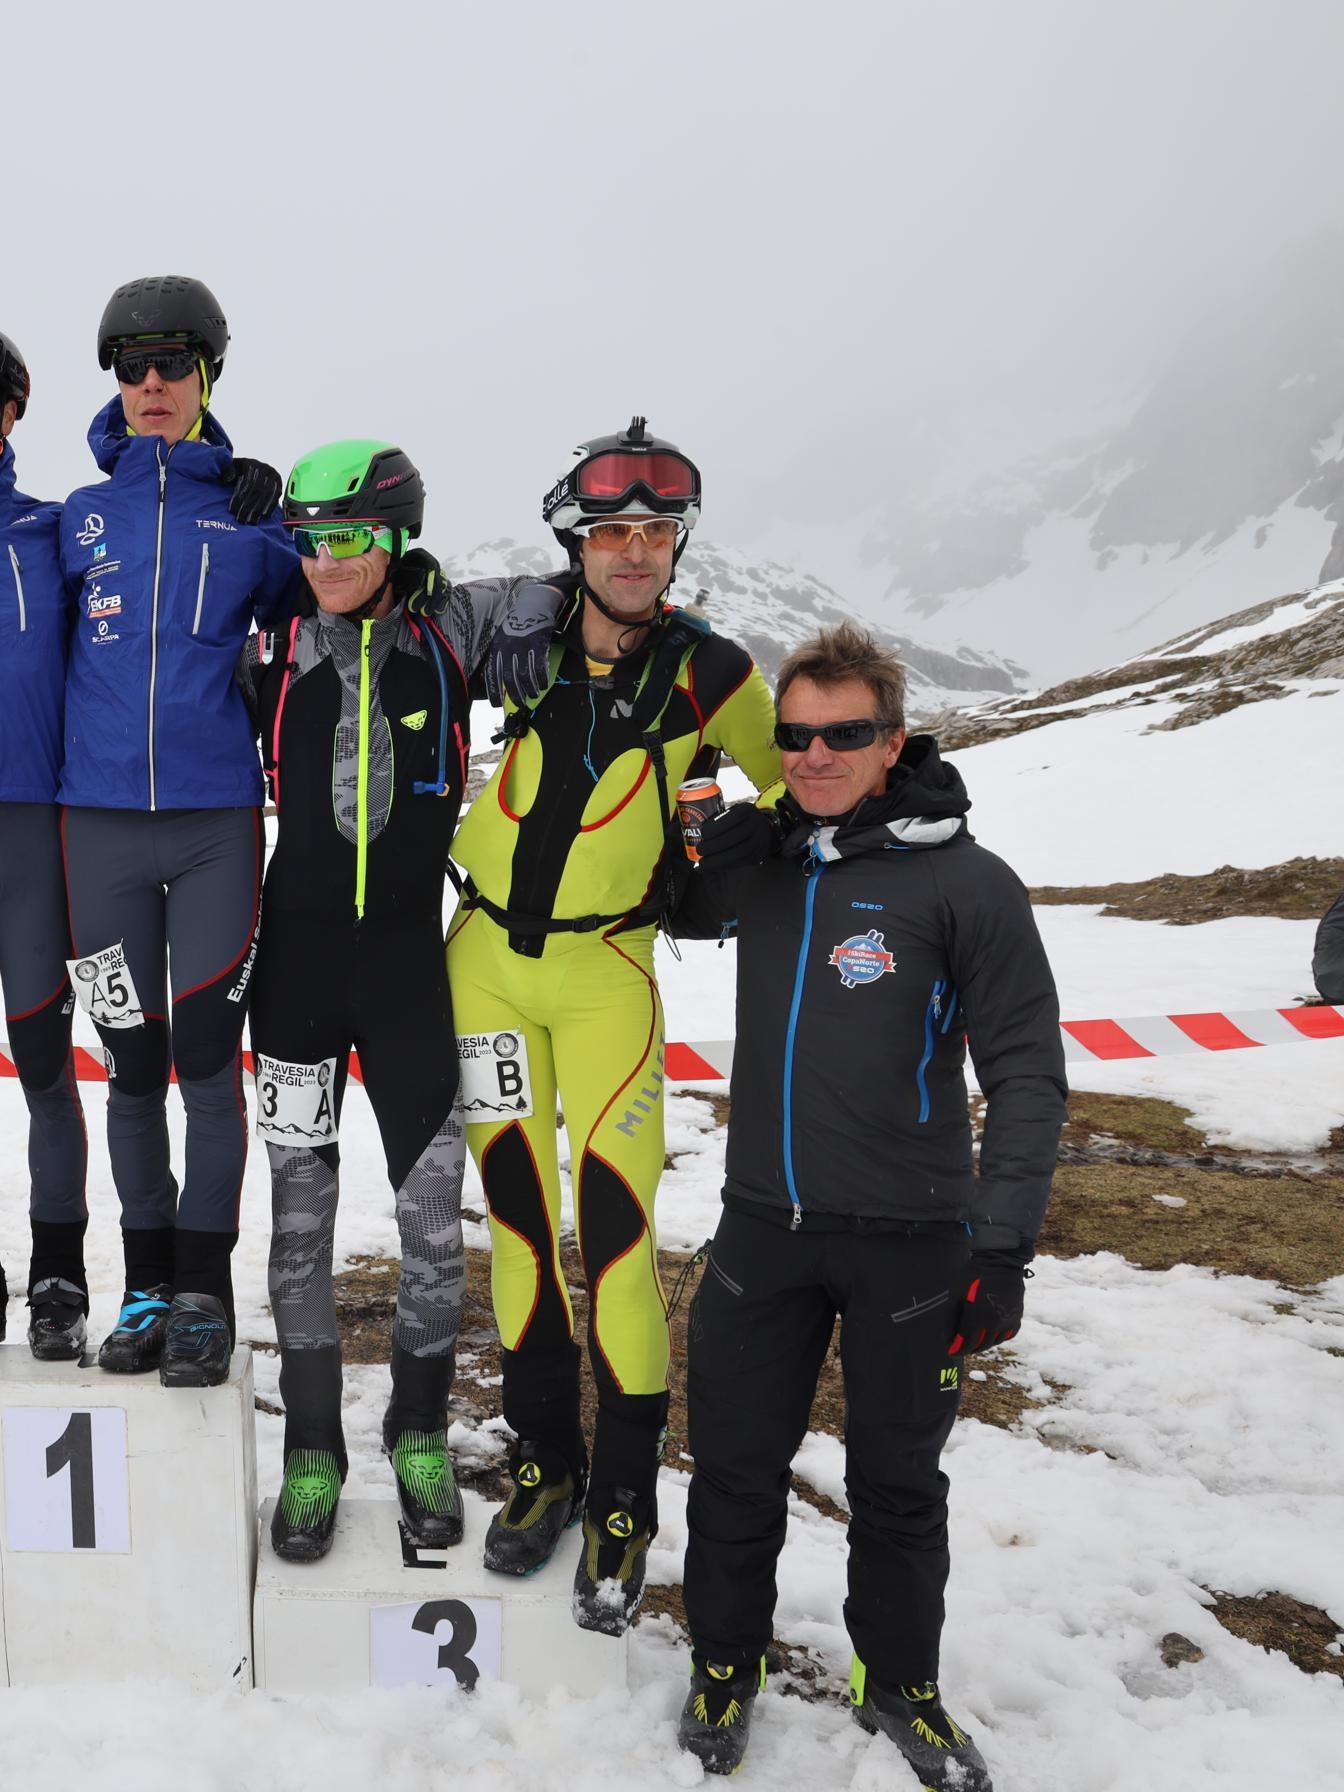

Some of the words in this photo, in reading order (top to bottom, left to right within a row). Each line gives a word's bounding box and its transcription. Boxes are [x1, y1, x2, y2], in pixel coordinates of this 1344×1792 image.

[544, 479, 569, 511] ollé
[196, 519, 238, 531] TERNUA
[90, 595, 122, 612] EKFB
[92, 634, 120, 643] SCARPA
[227, 942, 258, 1003] Euskal
[271, 1073, 304, 1087] REGIL
[496, 1060, 523, 1097] B
[262, 1082, 278, 1118] 3
[313, 1088, 332, 1124] A
[45, 1412, 96, 1549] 1
[411, 1599, 480, 1693] 3
